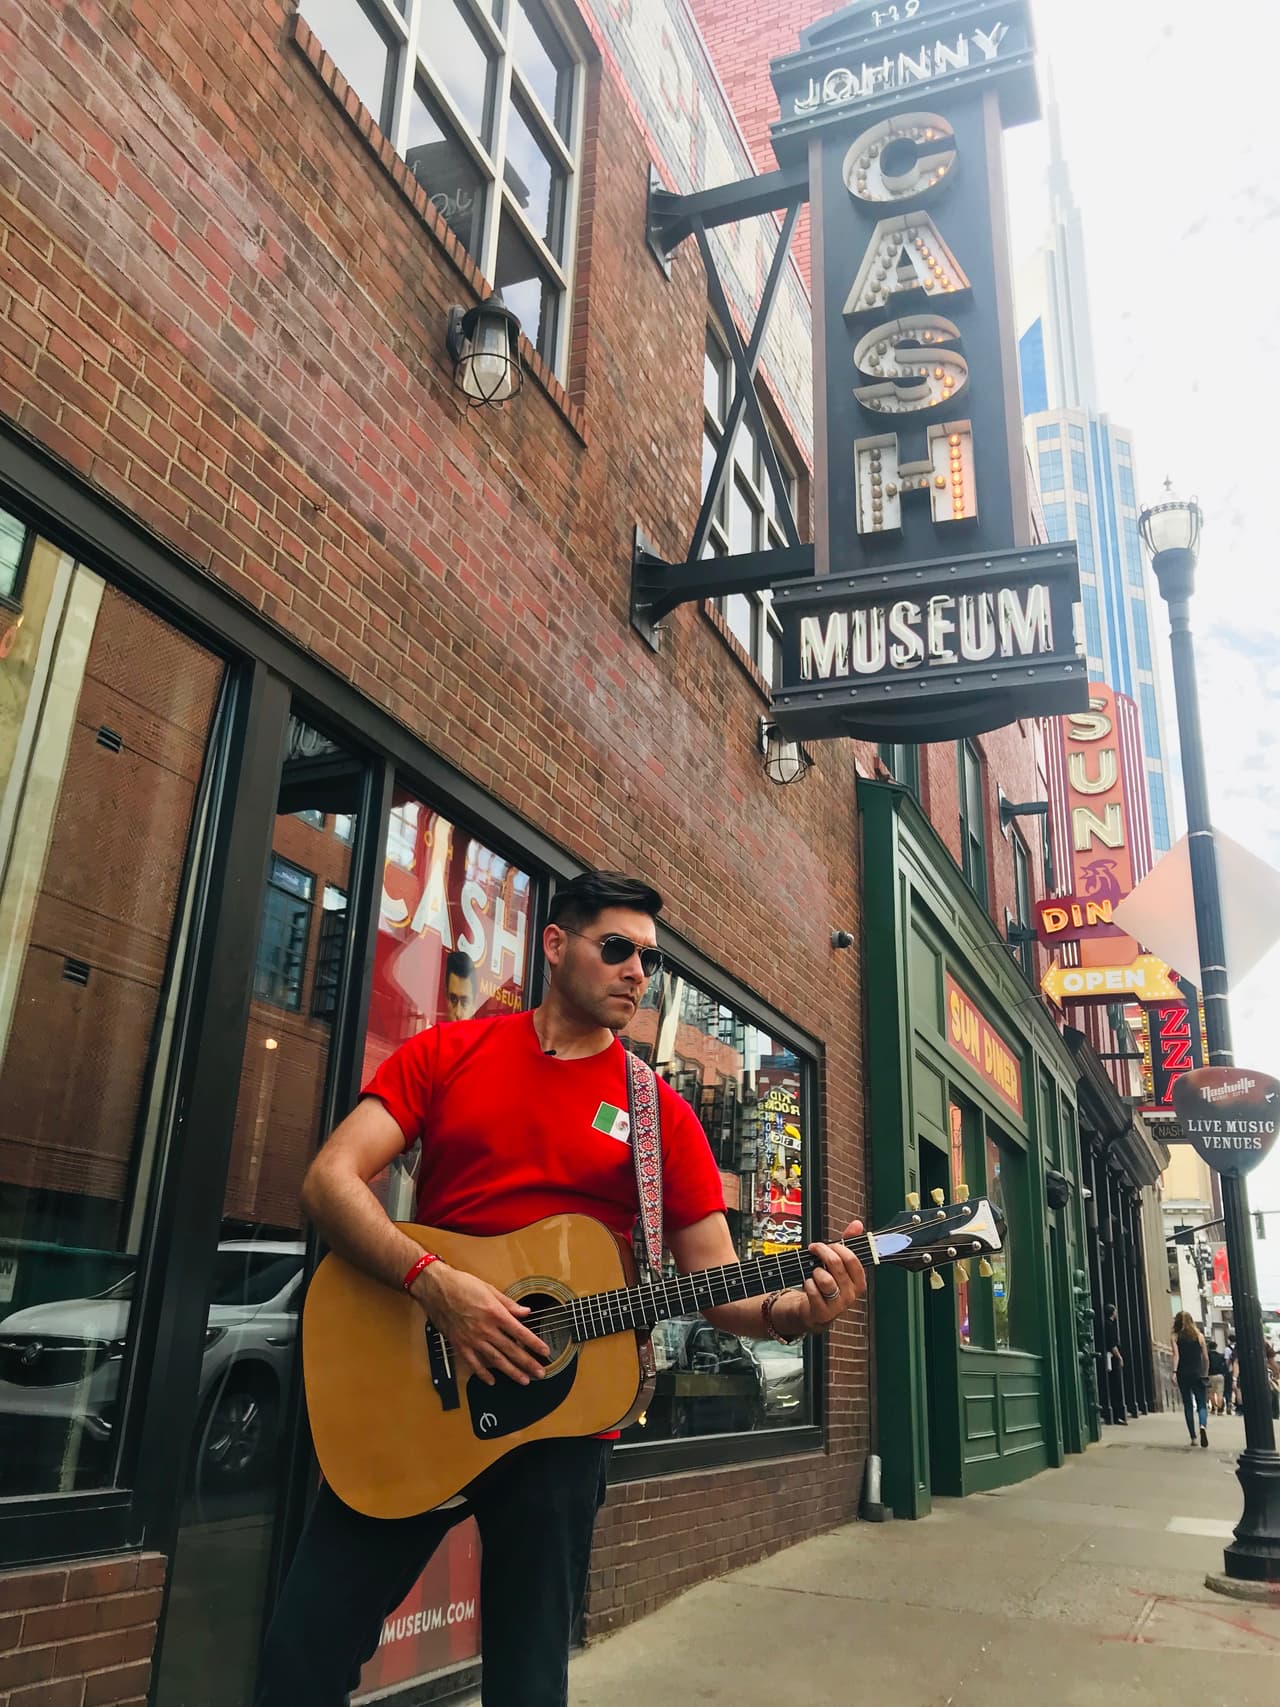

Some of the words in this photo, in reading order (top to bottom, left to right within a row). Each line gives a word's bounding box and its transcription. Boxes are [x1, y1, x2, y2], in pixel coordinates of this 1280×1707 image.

[794, 22, 1010, 115] JOHNNY
[842, 112, 978, 535] CASH
[799, 584, 1054, 680] MUSEUM
[1067, 697, 1126, 853] SUN
[1041, 899, 1125, 934] DIN
[479, 979, 523, 1012] MUSEUM
[1063, 968, 1145, 991] OPEN
[950, 990, 981, 1063] SUN
[983, 1027, 1019, 1105] DINER
[1200, 1077, 1256, 1103] Nashville
[1187, 1119, 1222, 1132] LIVE
[1226, 1120, 1275, 1134] MUSIC
[1202, 1136, 1263, 1150] VENUES
[378, 1597, 475, 1647] MUSEUM.COM
